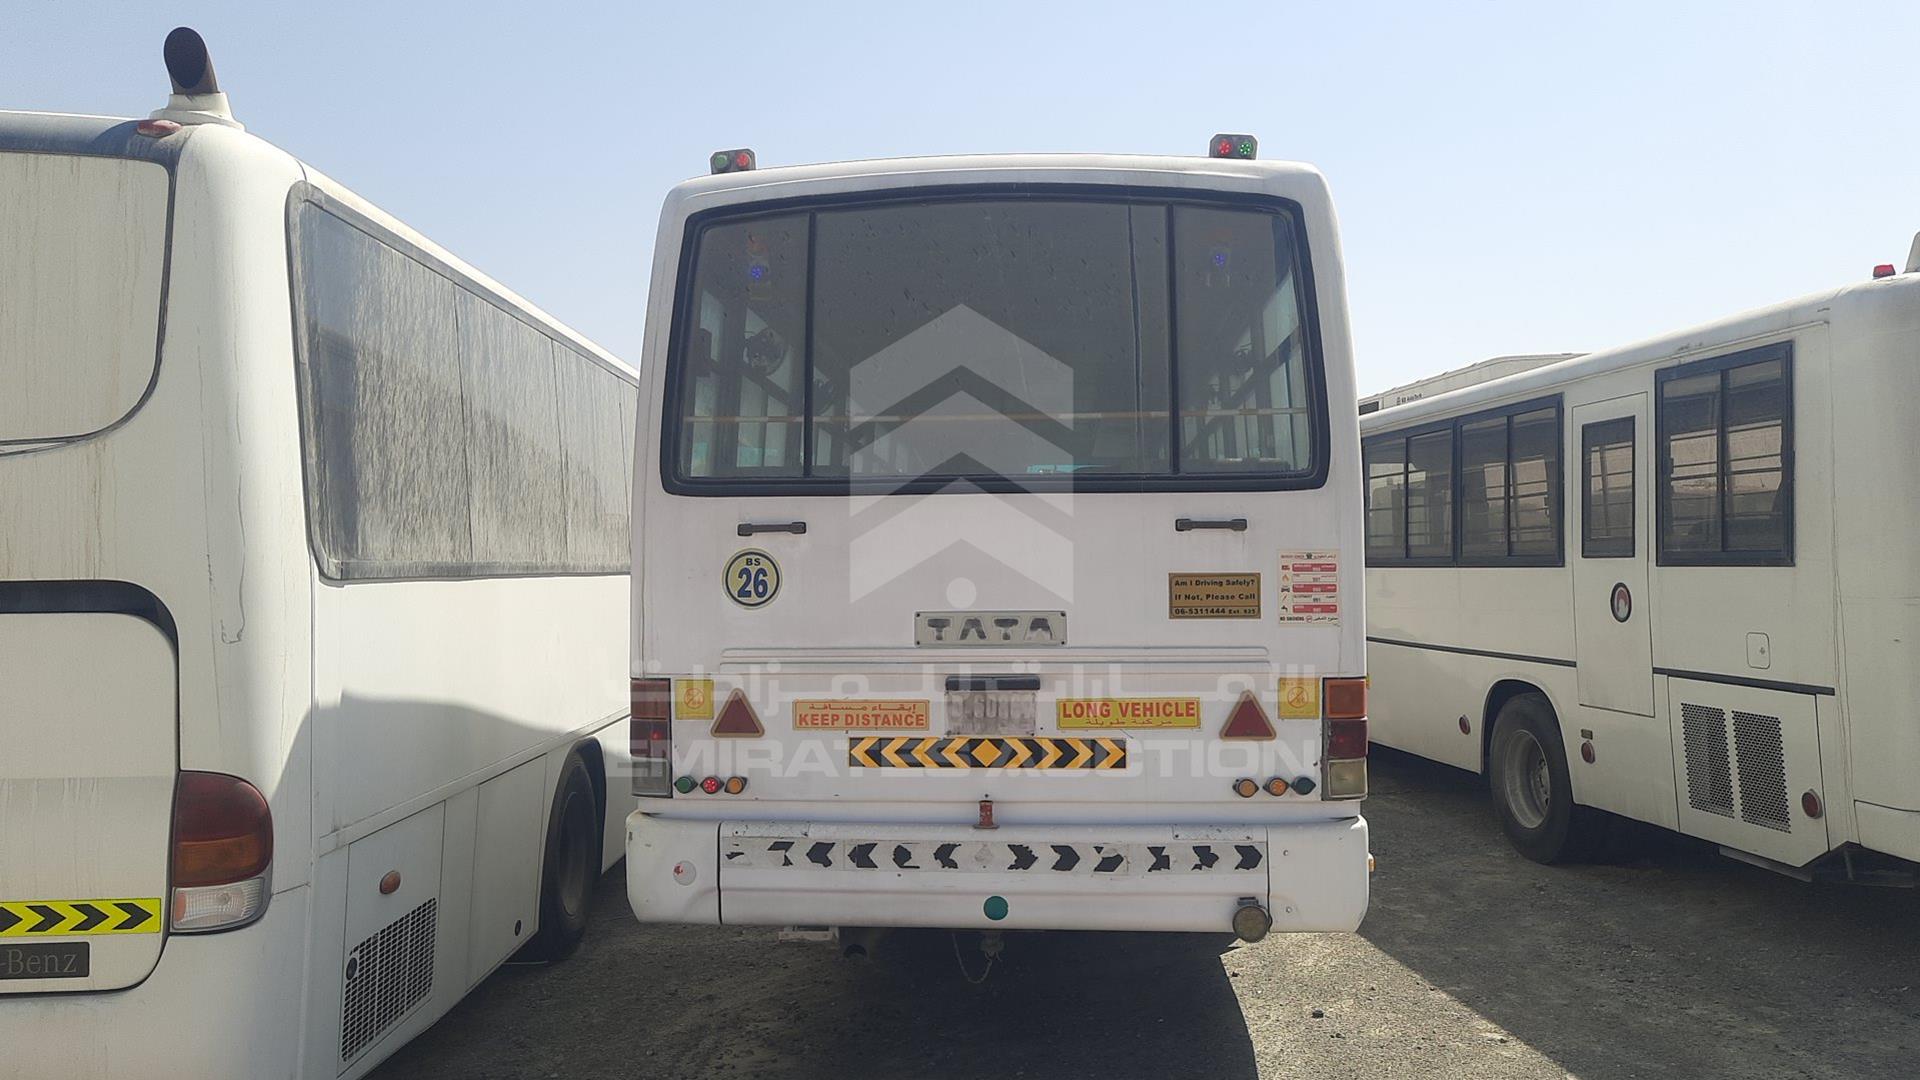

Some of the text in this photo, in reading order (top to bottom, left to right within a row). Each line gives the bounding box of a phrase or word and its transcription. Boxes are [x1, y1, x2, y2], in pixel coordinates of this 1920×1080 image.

[746, 558, 761, 566] BS
[737, 567, 768, 598] 26
[1195, 579, 1223, 587] Driving
[927, 617, 1054, 641] TATA
[1062, 702, 1196, 718] LONG VEHICLE
[799, 713, 925, 727] KEEP DISTANCE
